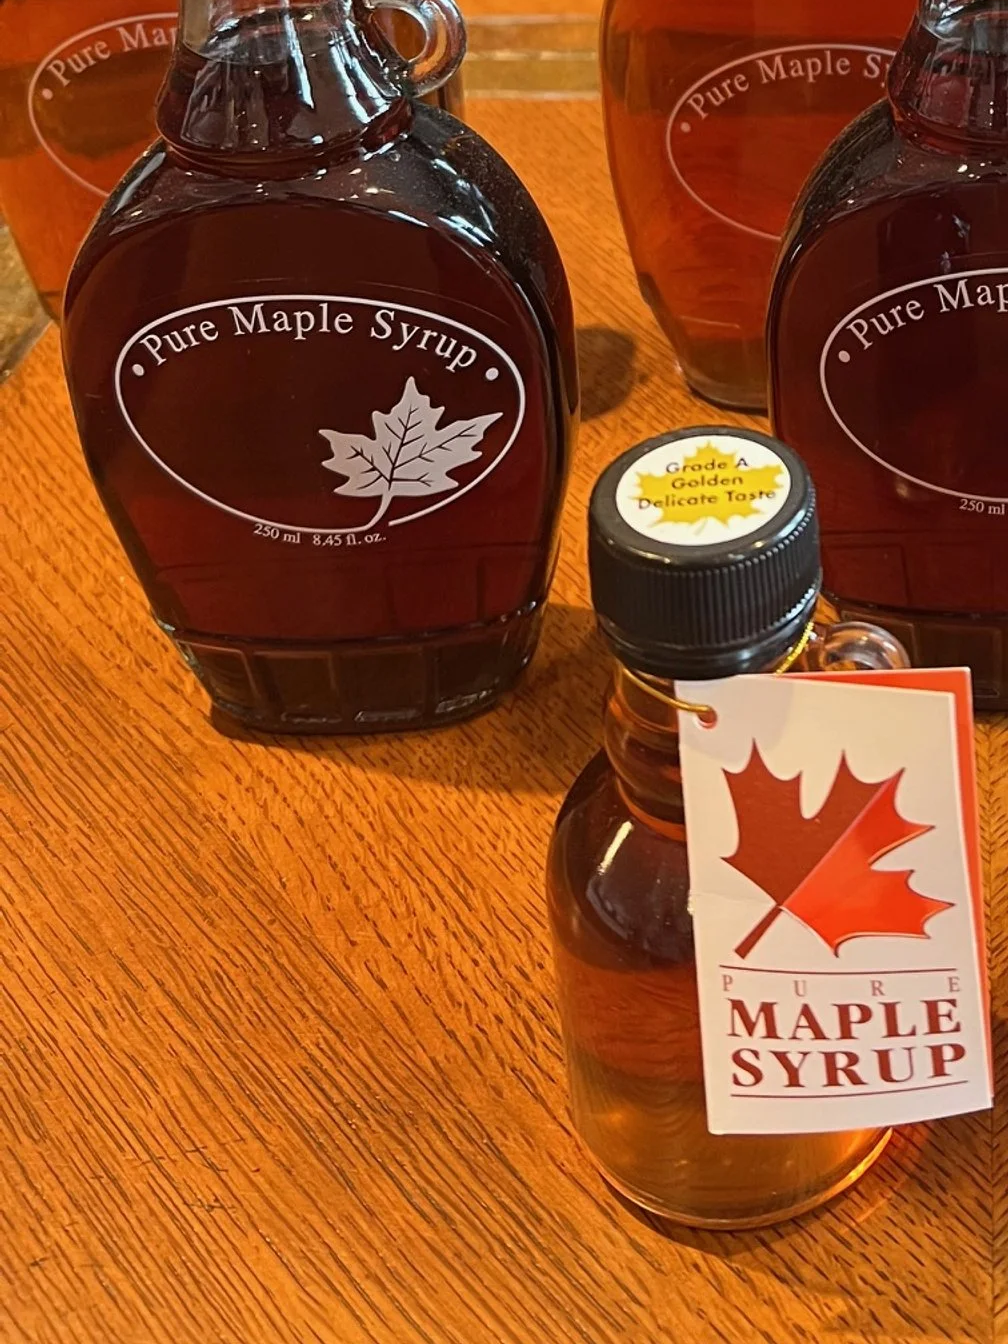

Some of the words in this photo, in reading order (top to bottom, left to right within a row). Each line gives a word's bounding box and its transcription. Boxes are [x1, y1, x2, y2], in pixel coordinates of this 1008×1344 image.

[46, 40, 111, 87] Pure
[687, 73, 750, 120] Pure
[756, 50, 851, 84] Maple
[139, 320, 219, 366] Pure
[228, 303, 354, 341] Maple
[370, 308, 478, 373] Syrup
[846, 296, 925, 351] Pure
[665, 458, 728, 474] Grade
[734, 457, 749, 468] A
[671, 475, 744, 490] Golden
[638, 495, 719, 510] Delicate
[726, 489, 776, 502] Taste
[959, 498, 985, 513] 250
[987, 503, 1006, 515] ml
[253, 523, 280, 539] 250
[283, 532, 301, 544] ml
[312, 534, 343, 547] 8.45
[346, 533, 362, 546] fl.
[364, 532, 387, 544] oz.
[726, 997, 961, 1041] MAPLE
[731, 1042, 966, 1088] SYRUP
